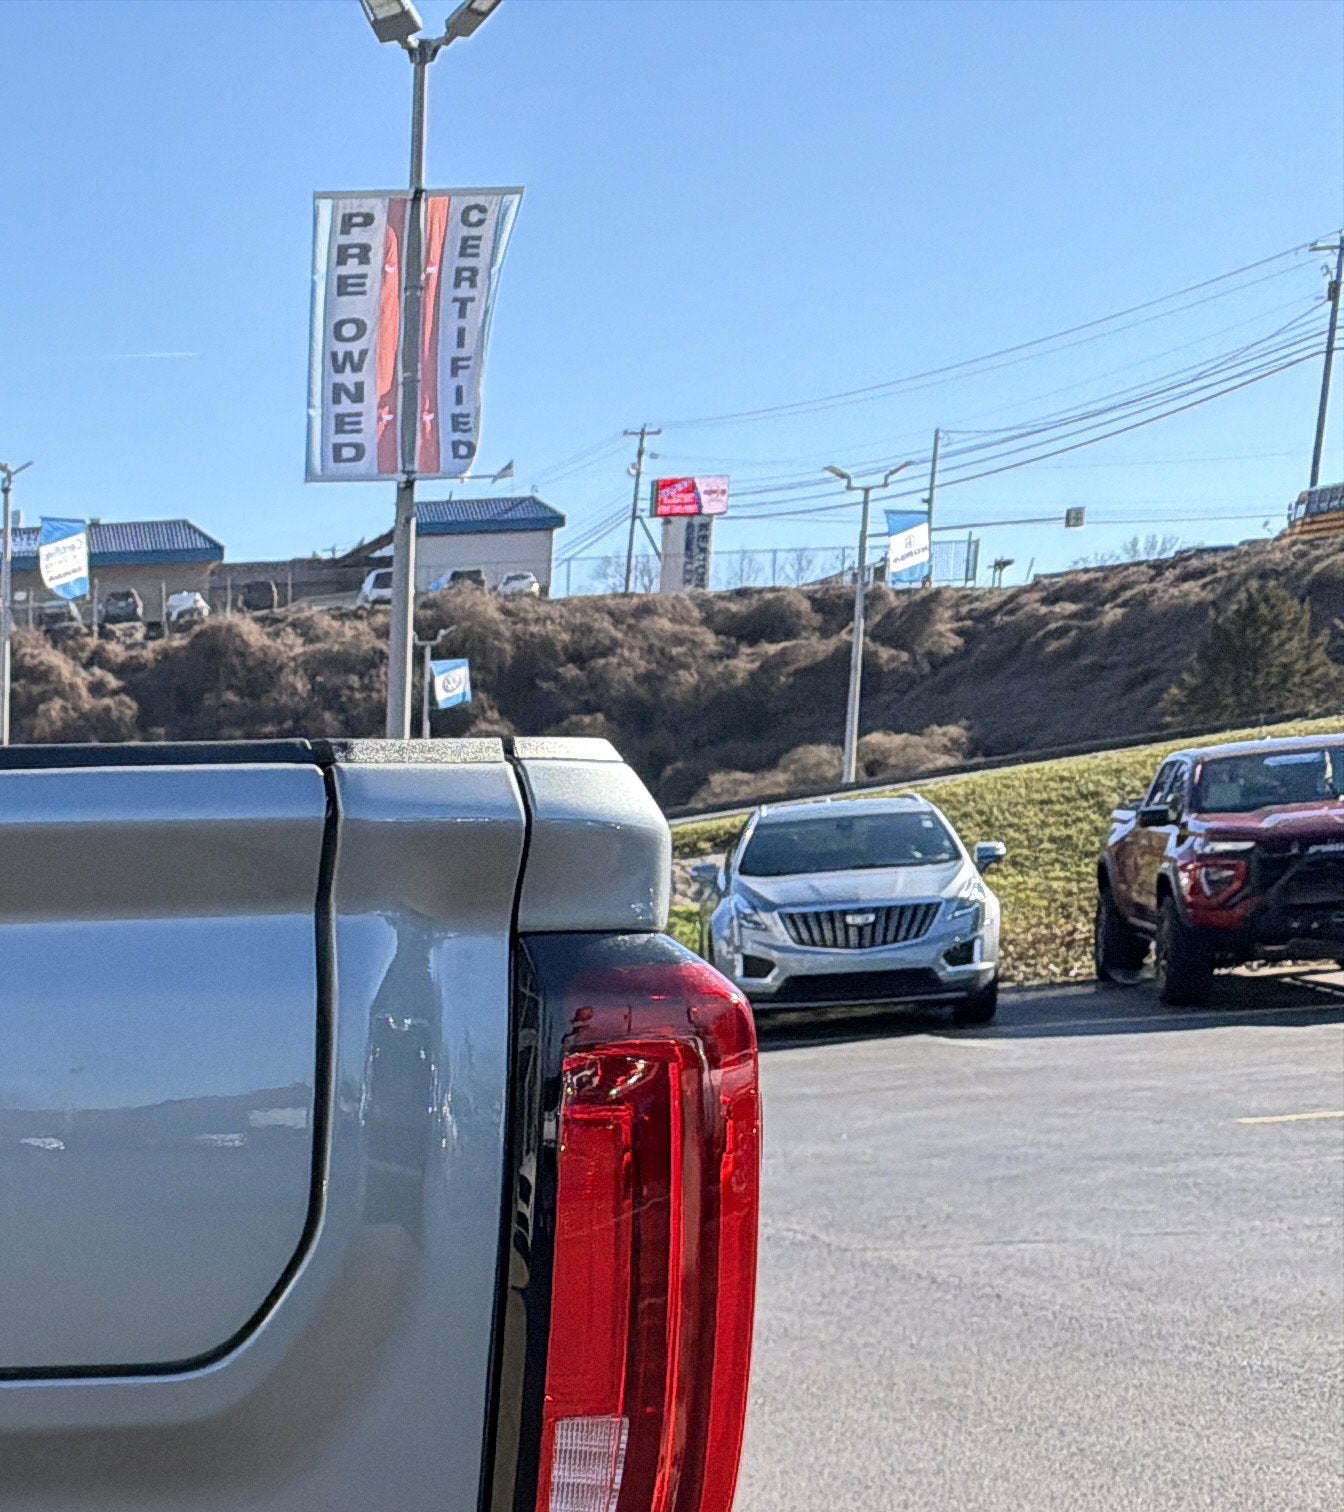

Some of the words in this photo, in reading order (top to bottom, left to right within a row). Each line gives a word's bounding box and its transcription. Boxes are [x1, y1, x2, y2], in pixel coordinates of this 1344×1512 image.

[336, 211, 375, 297] PRE
[330, 316, 369, 464] OWNED
[449, 203, 488, 461] CERTIFIED
